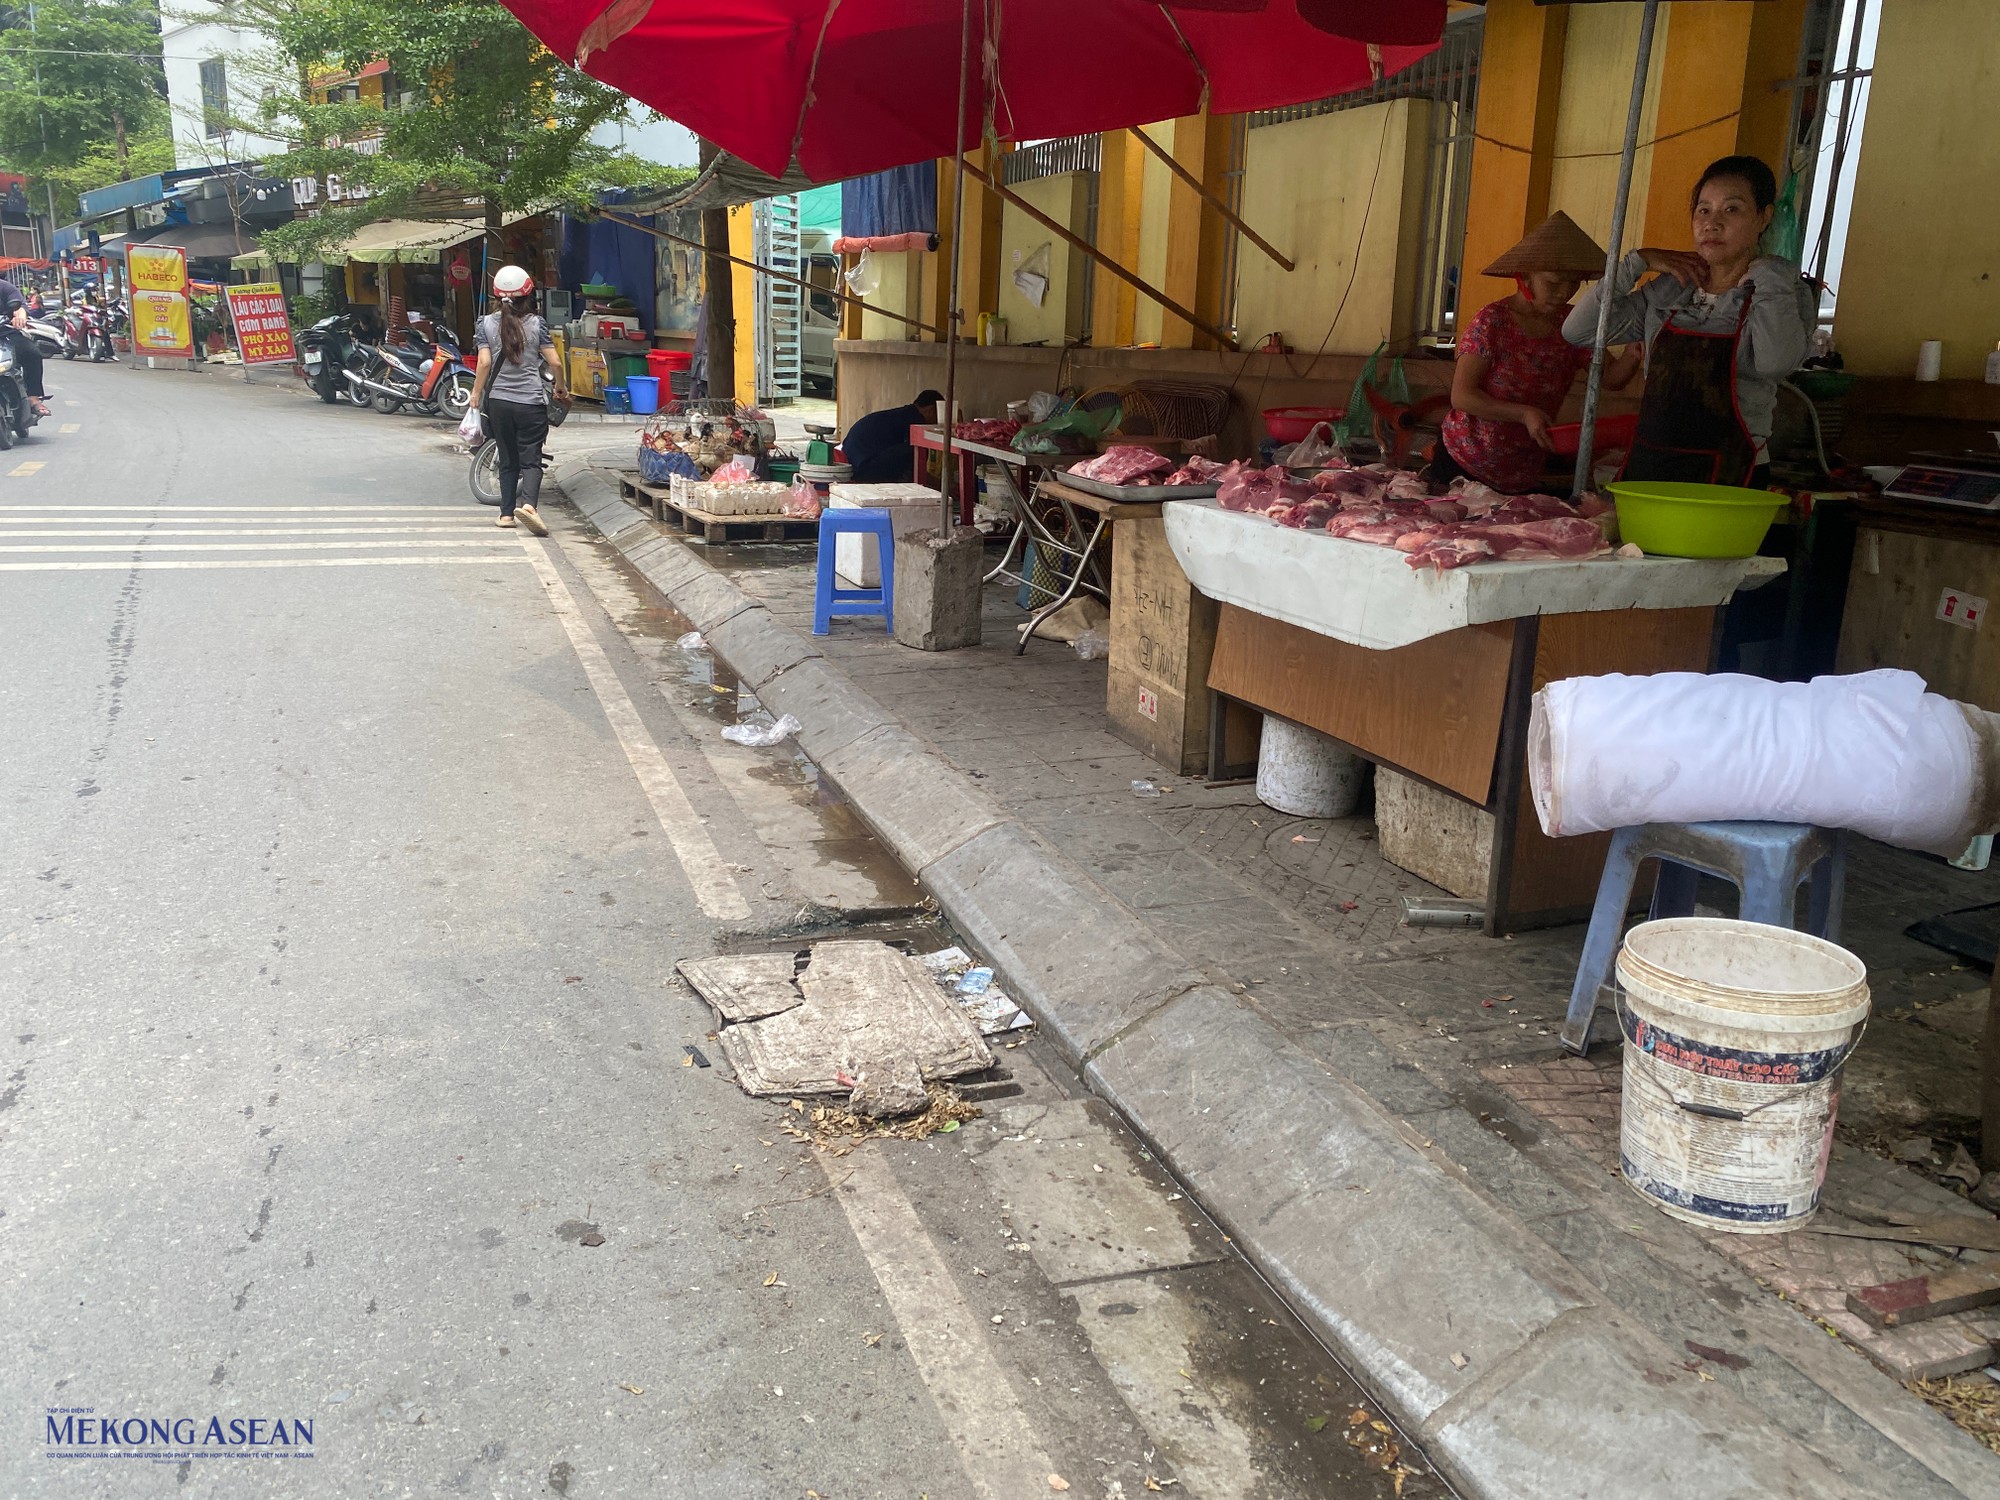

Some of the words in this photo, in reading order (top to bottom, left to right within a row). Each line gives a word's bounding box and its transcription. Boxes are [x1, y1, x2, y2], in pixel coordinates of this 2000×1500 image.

[73, 260, 97, 271] 313
[137, 272, 178, 282] HABECO
[249, 298, 265, 315] CÁC
[265, 297, 284, 316] LOẠI
[239, 318, 260, 333] CƠM
[262, 316, 287, 330] RANG
[243, 331, 264, 345] PHỞ
[1679, 1047, 1703, 1065] NỘI
[1706, 1055, 1741, 1072] THẤT
[1742, 1062, 1772, 1075] CAO
[1773, 1060, 1800, 1076] CẤP
[1707, 1067, 1764, 1083] INTERIOR
[1765, 1075, 1800, 1084] PAINT
